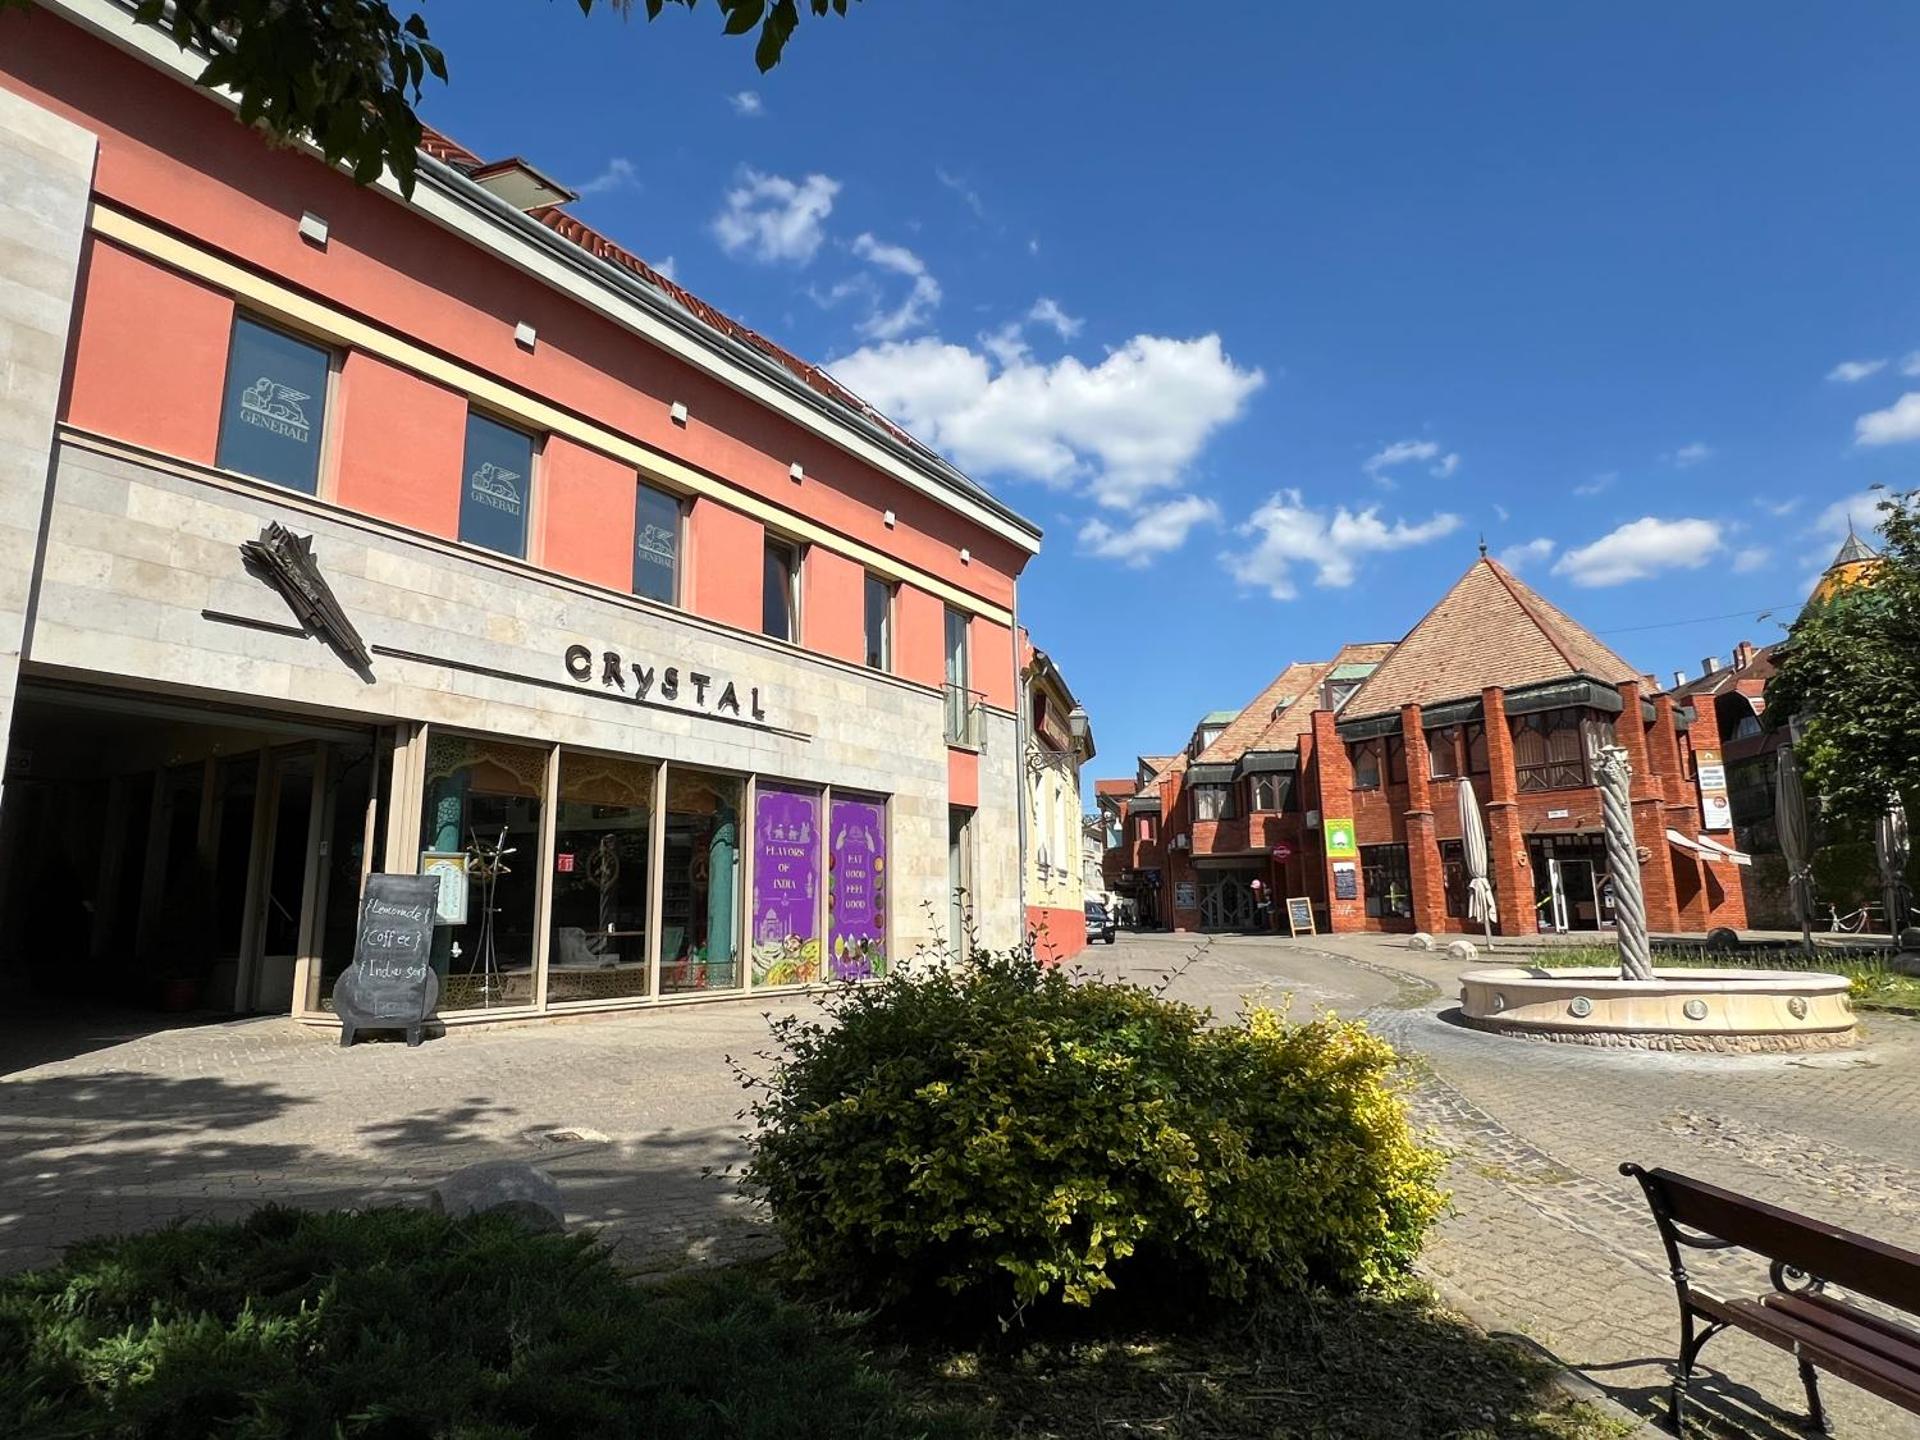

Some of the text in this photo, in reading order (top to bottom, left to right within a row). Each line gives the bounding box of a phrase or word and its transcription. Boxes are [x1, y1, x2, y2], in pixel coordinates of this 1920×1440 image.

[240, 409, 308, 443] GENERALI
[471, 490, 520, 516] GENERALI
[766, 846, 805, 857] FLAVORS
[778, 863, 790, 872] OF
[773, 879, 796, 889] INDIA
